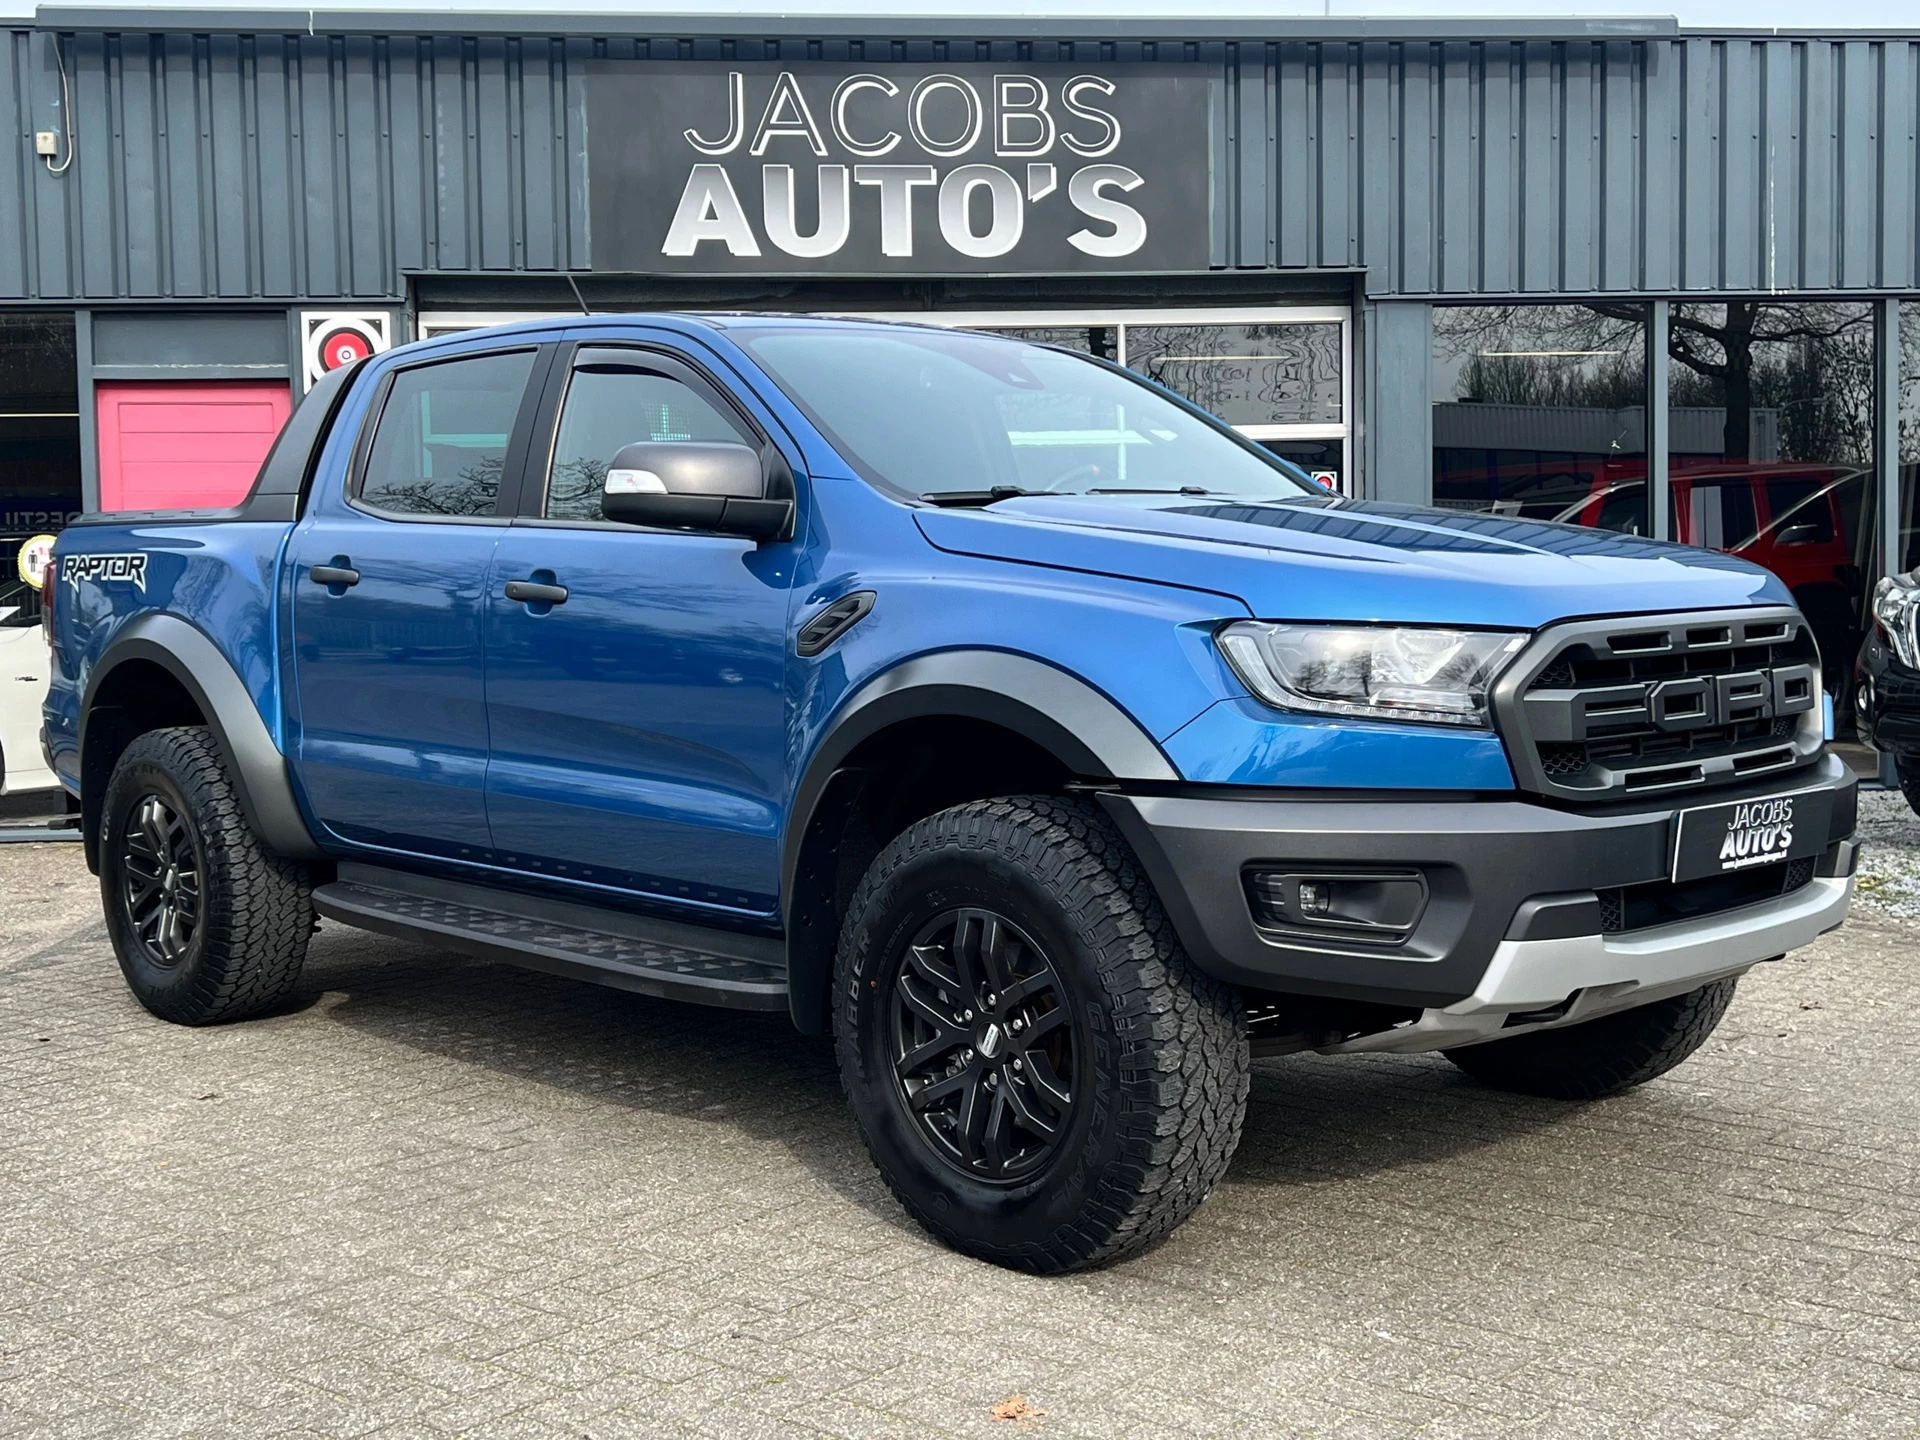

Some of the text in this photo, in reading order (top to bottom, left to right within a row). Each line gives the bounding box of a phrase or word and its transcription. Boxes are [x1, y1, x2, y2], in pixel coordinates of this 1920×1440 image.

[683, 72, 1121, 157] JACOBS
[661, 163, 1147, 258] AUTO'S
[61, 553, 148, 594] RAPTOR
[1524, 664, 1815, 742] FORD
[1719, 821, 1794, 859] AUTO'S
[1727, 797, 1793, 830] JACOBS
[1050, 1001, 1112, 1208] GENERAL
